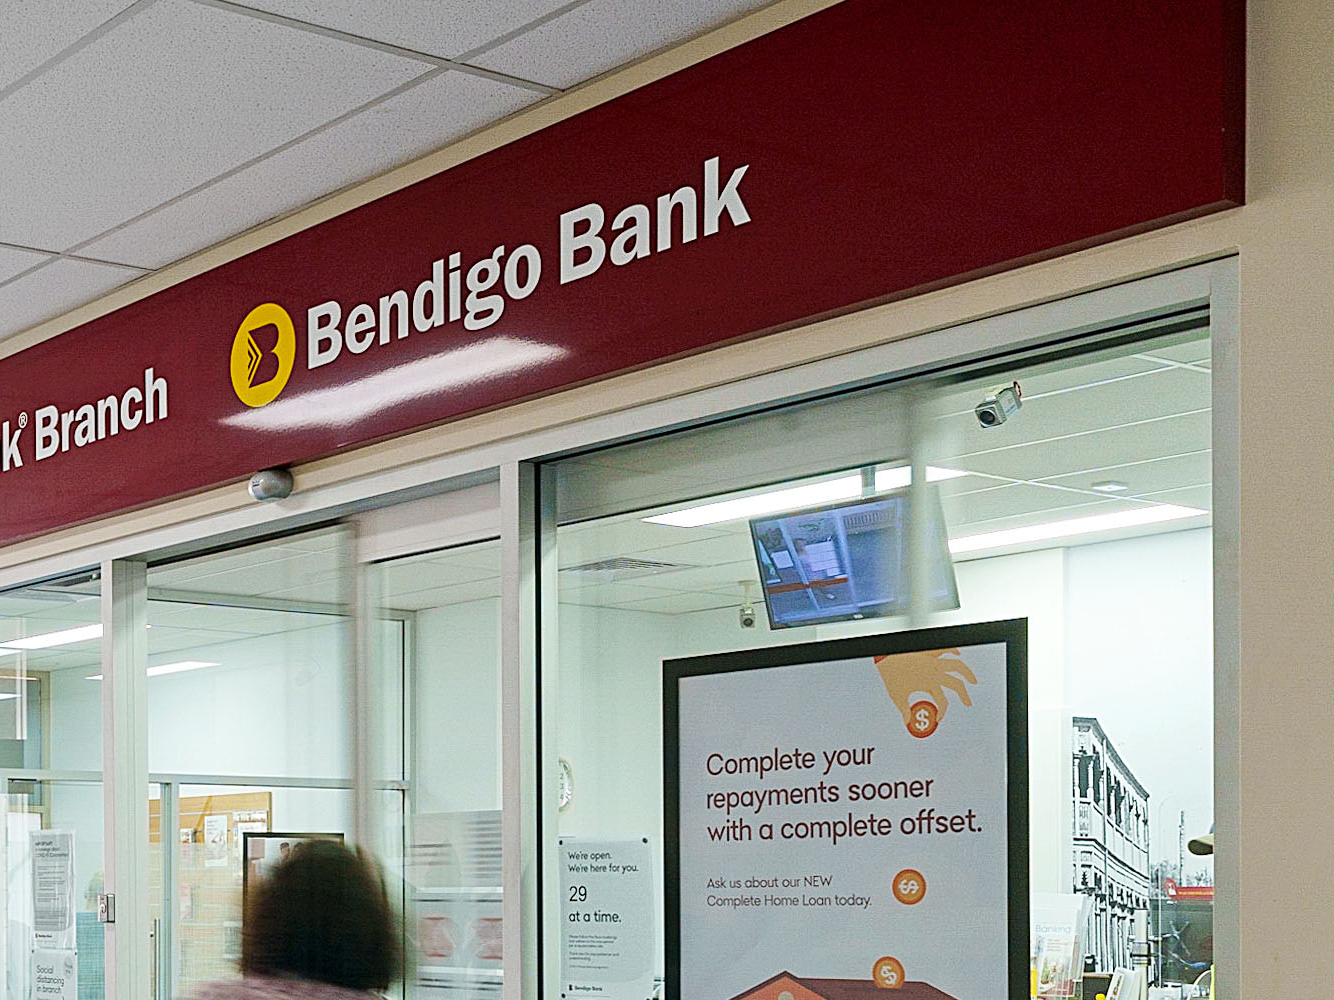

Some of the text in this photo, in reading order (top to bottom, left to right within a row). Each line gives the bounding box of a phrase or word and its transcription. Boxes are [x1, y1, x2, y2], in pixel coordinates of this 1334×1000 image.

[307, 243, 542, 371] Bendigo
[560, 156, 752, 285] Bank
[35, 367, 168, 462] Branch
[706, 744, 875, 779] Complete your
[706, 779, 934, 814] repayments sooner
[707, 808, 983, 845] with a complete offset.
[567, 851, 612, 862] We're open.
[567, 863, 640, 874] We're here for you.
[706, 875, 833, 890] Ask us about our NEW
[569, 885, 587, 902] 29
[706, 893, 873, 911] Complete Home Loan today.
[568, 910, 622, 923] at a time.
